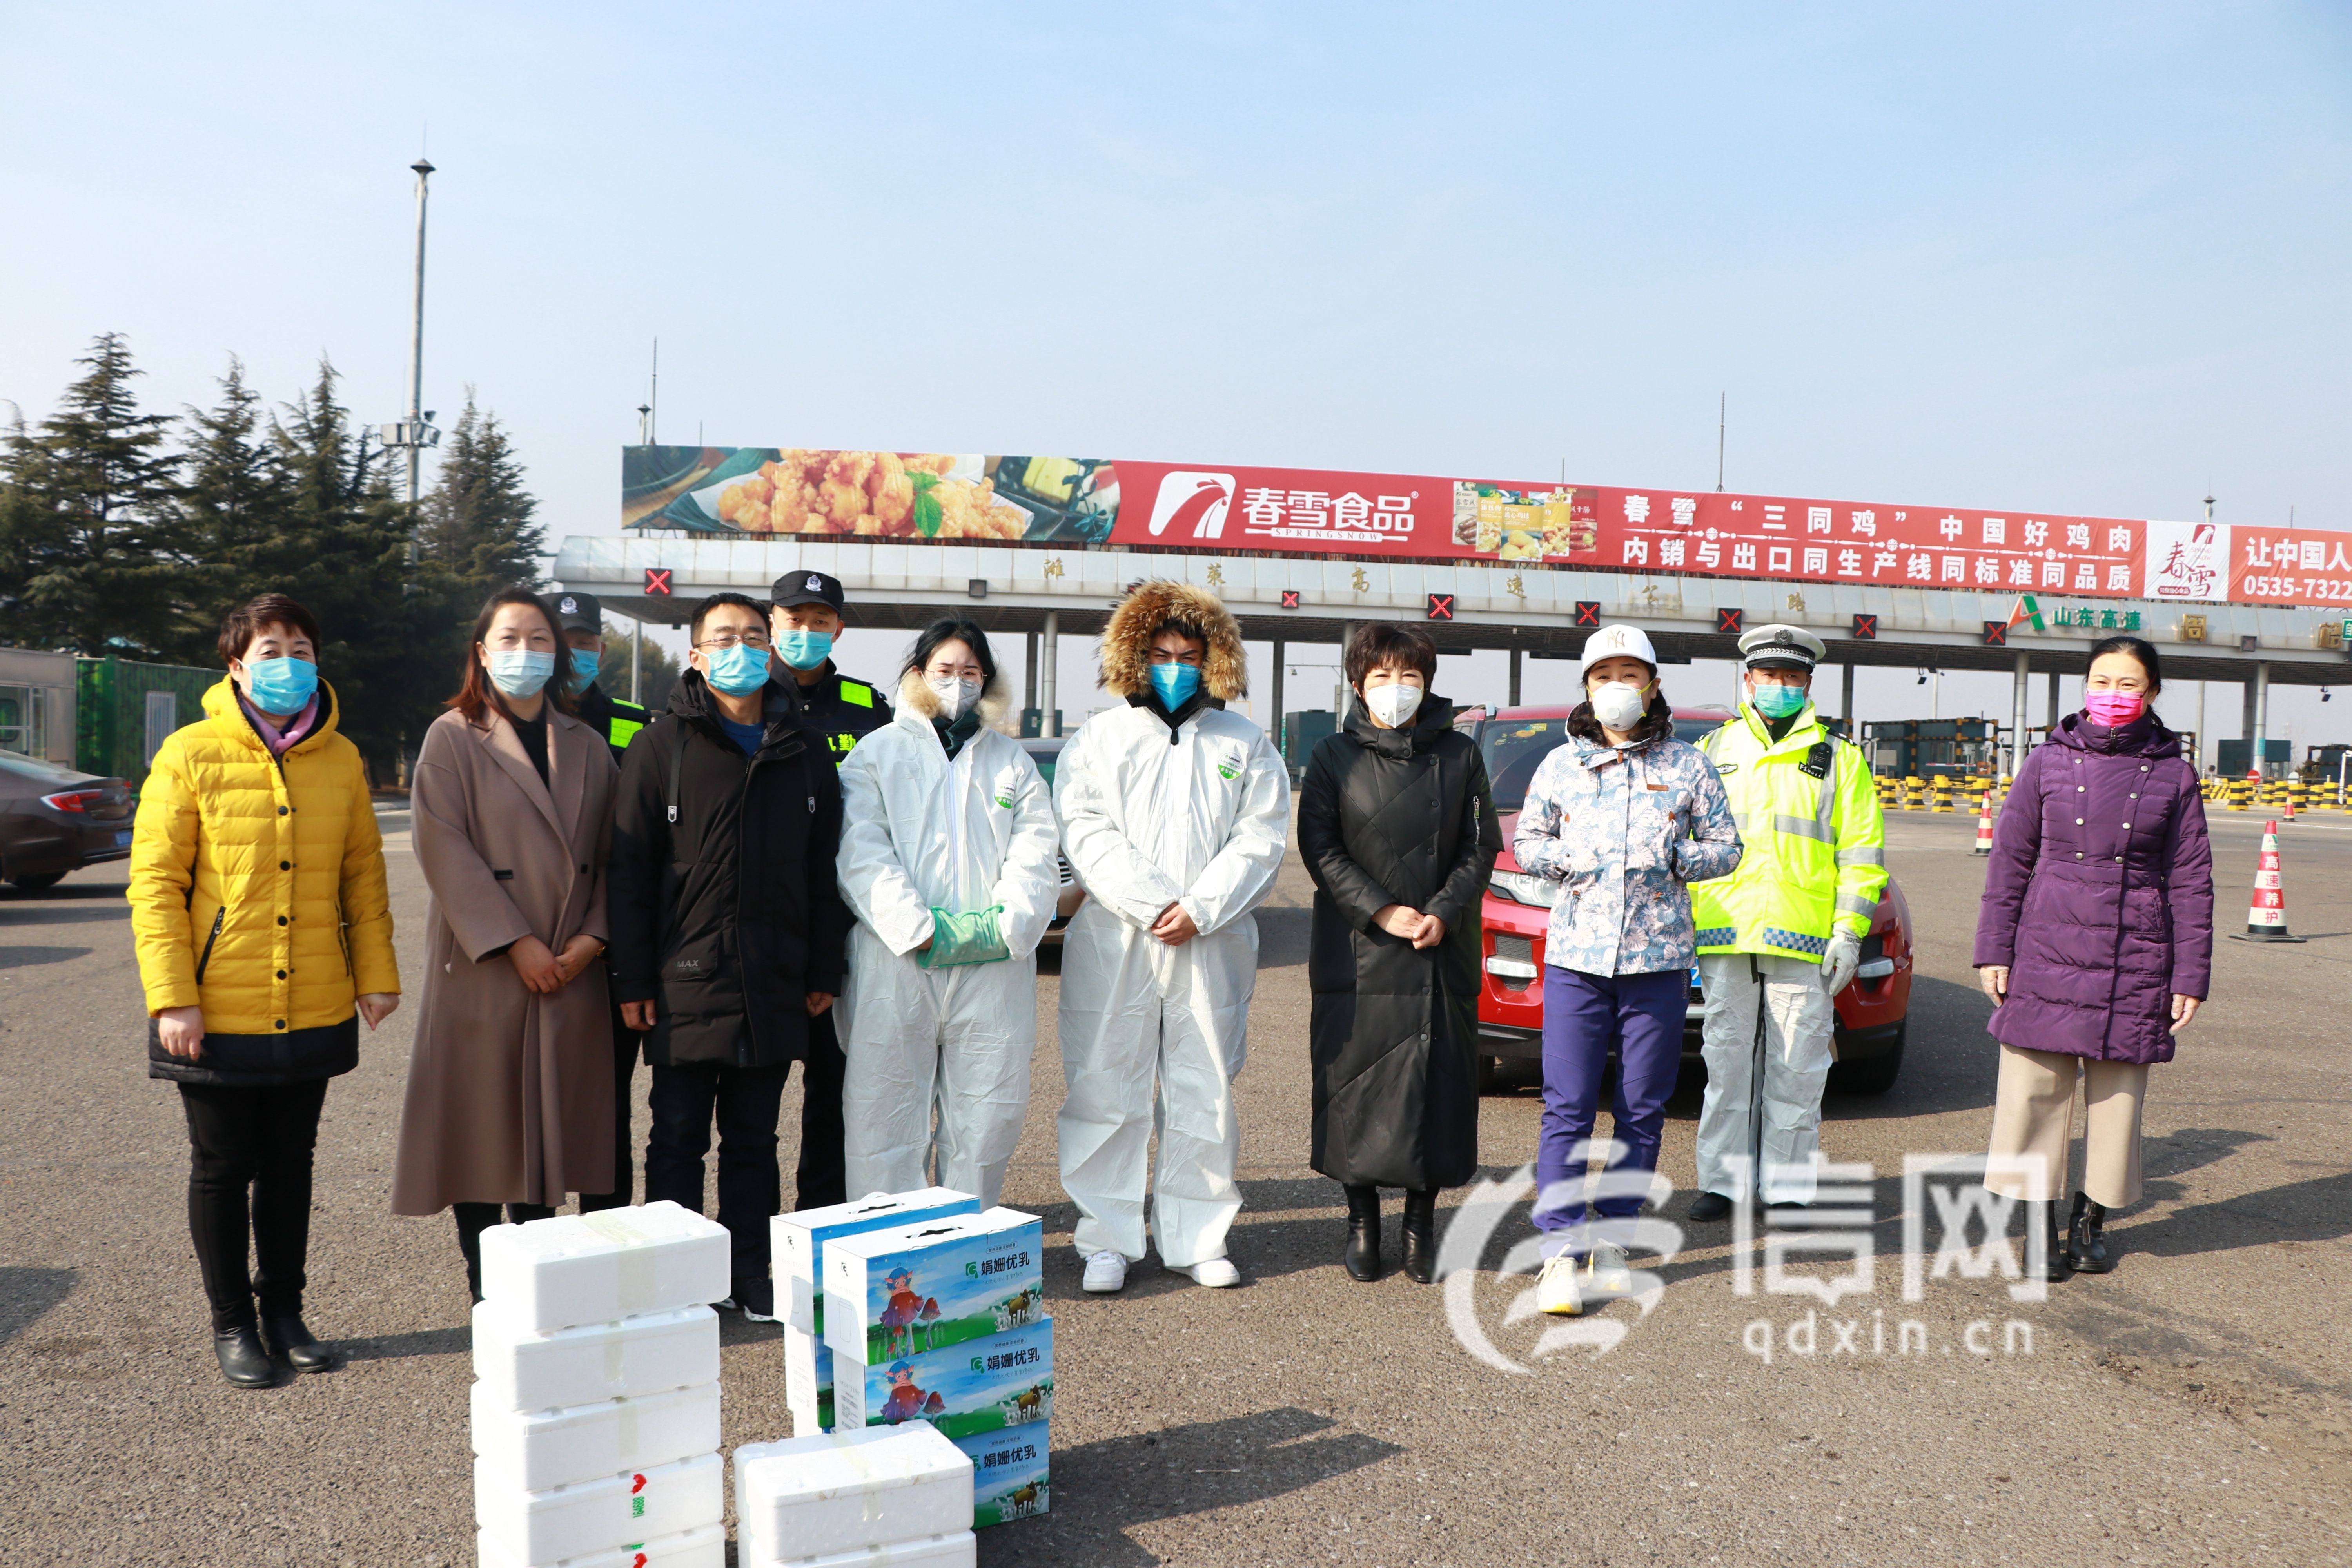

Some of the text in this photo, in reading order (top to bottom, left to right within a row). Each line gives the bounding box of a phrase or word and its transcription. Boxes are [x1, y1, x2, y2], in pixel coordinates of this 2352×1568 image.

[1243, 487, 1414, 532] 春雪食品
[1276, 528, 1379, 540] SPRINGSNOW
[1623, 537, 2131, 591] 内销与出口同生产线同标准同品质
[2052, 606, 2141, 630] 山东高速
[2264, 855, 2279, 924] 高速养护
[981, 1251, 1030, 1276] 娟姗优乳
[987, 1347, 1040, 1371] 娟姗优乳
[984, 1444, 1036, 1468] 娟姗优乳
